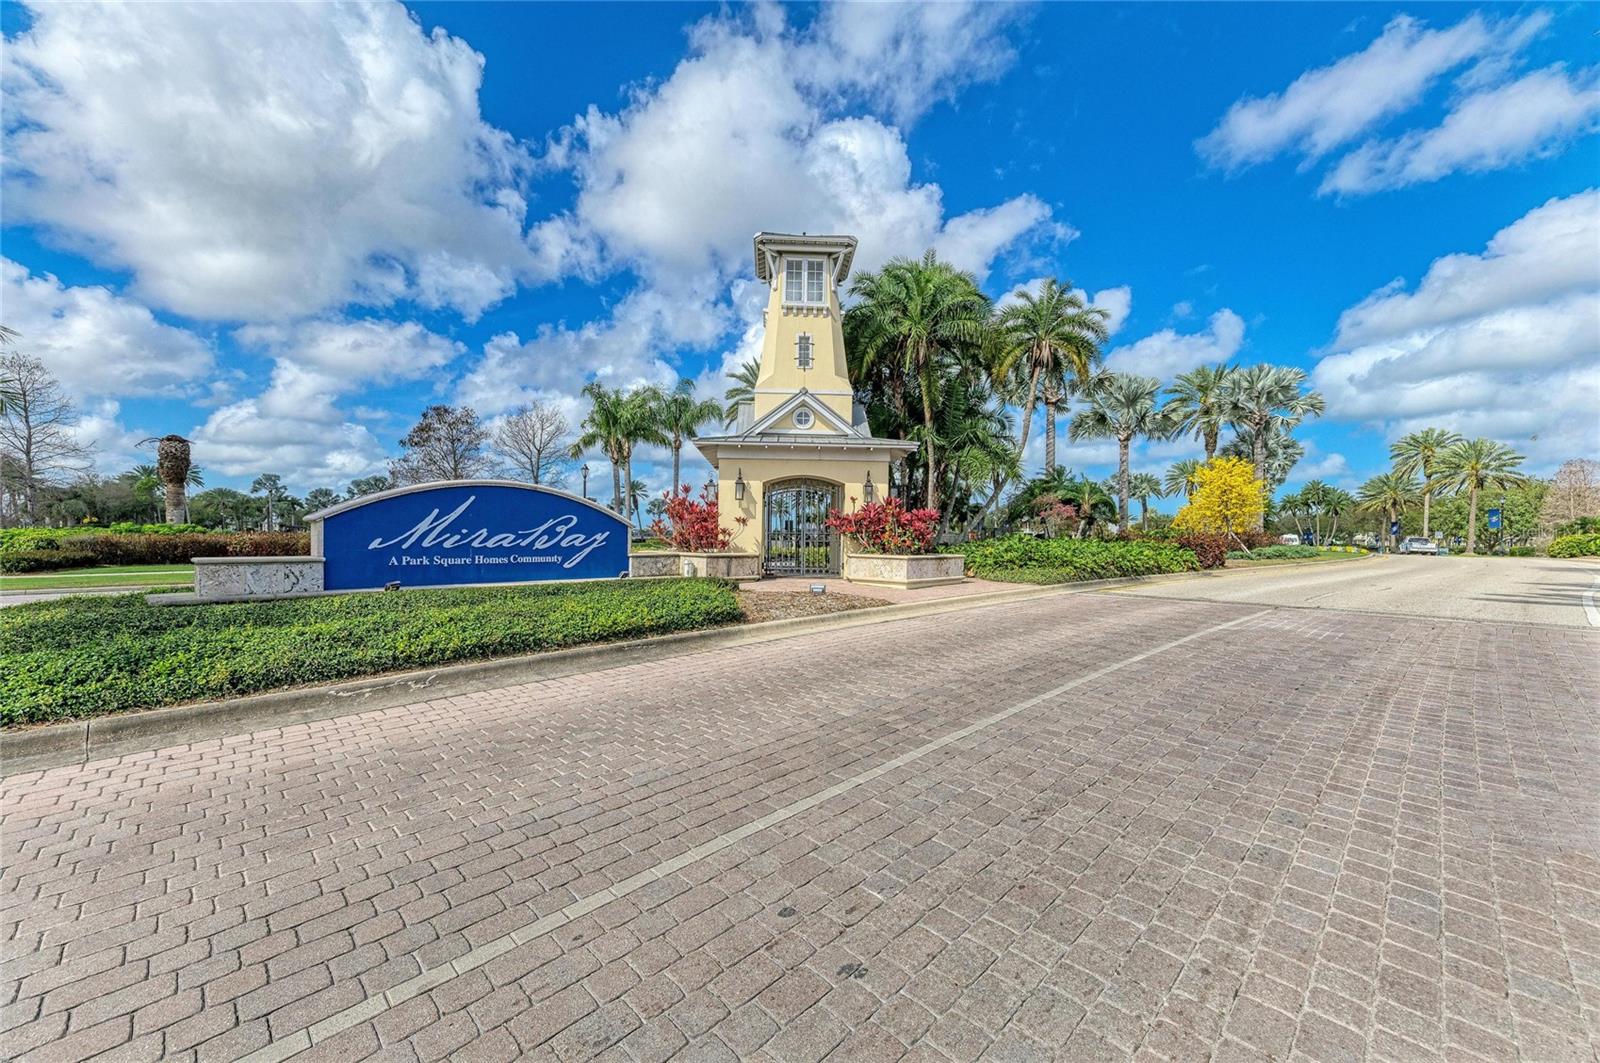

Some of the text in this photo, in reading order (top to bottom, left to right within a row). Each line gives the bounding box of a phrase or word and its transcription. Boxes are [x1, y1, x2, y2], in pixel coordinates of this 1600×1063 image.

[388, 554, 563, 567] A Park Square Homes Community
